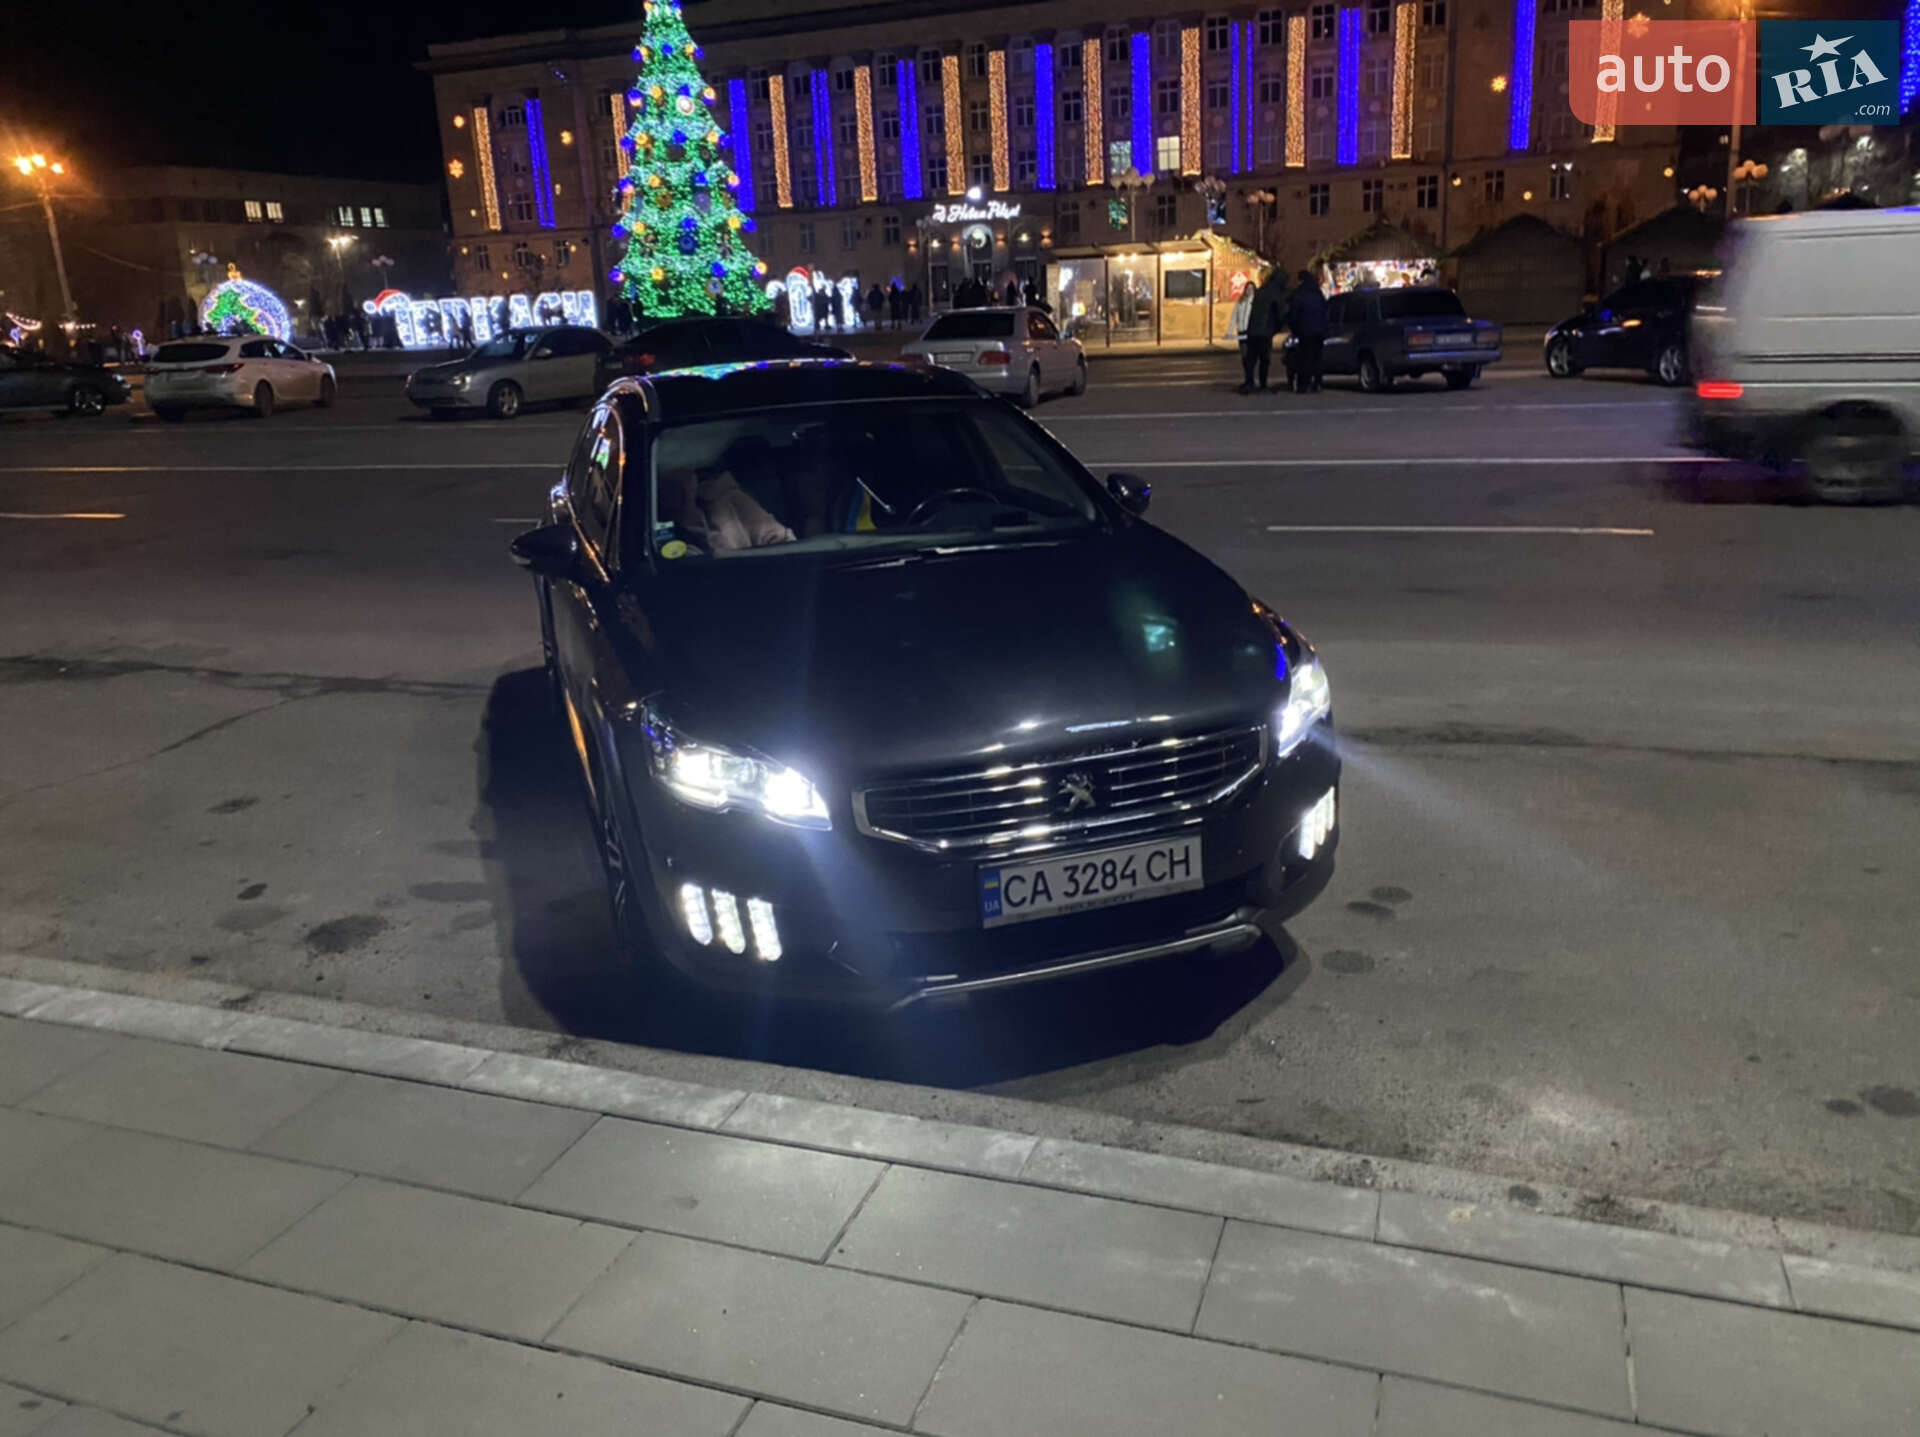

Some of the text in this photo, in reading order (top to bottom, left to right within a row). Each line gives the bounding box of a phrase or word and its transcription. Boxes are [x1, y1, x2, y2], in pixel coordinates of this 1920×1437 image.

[1003, 870, 1054, 909] CA
[1062, 854, 1137, 899] 3284
[1145, 845, 1191, 883] CH
[983, 899, 1000, 912] UA
